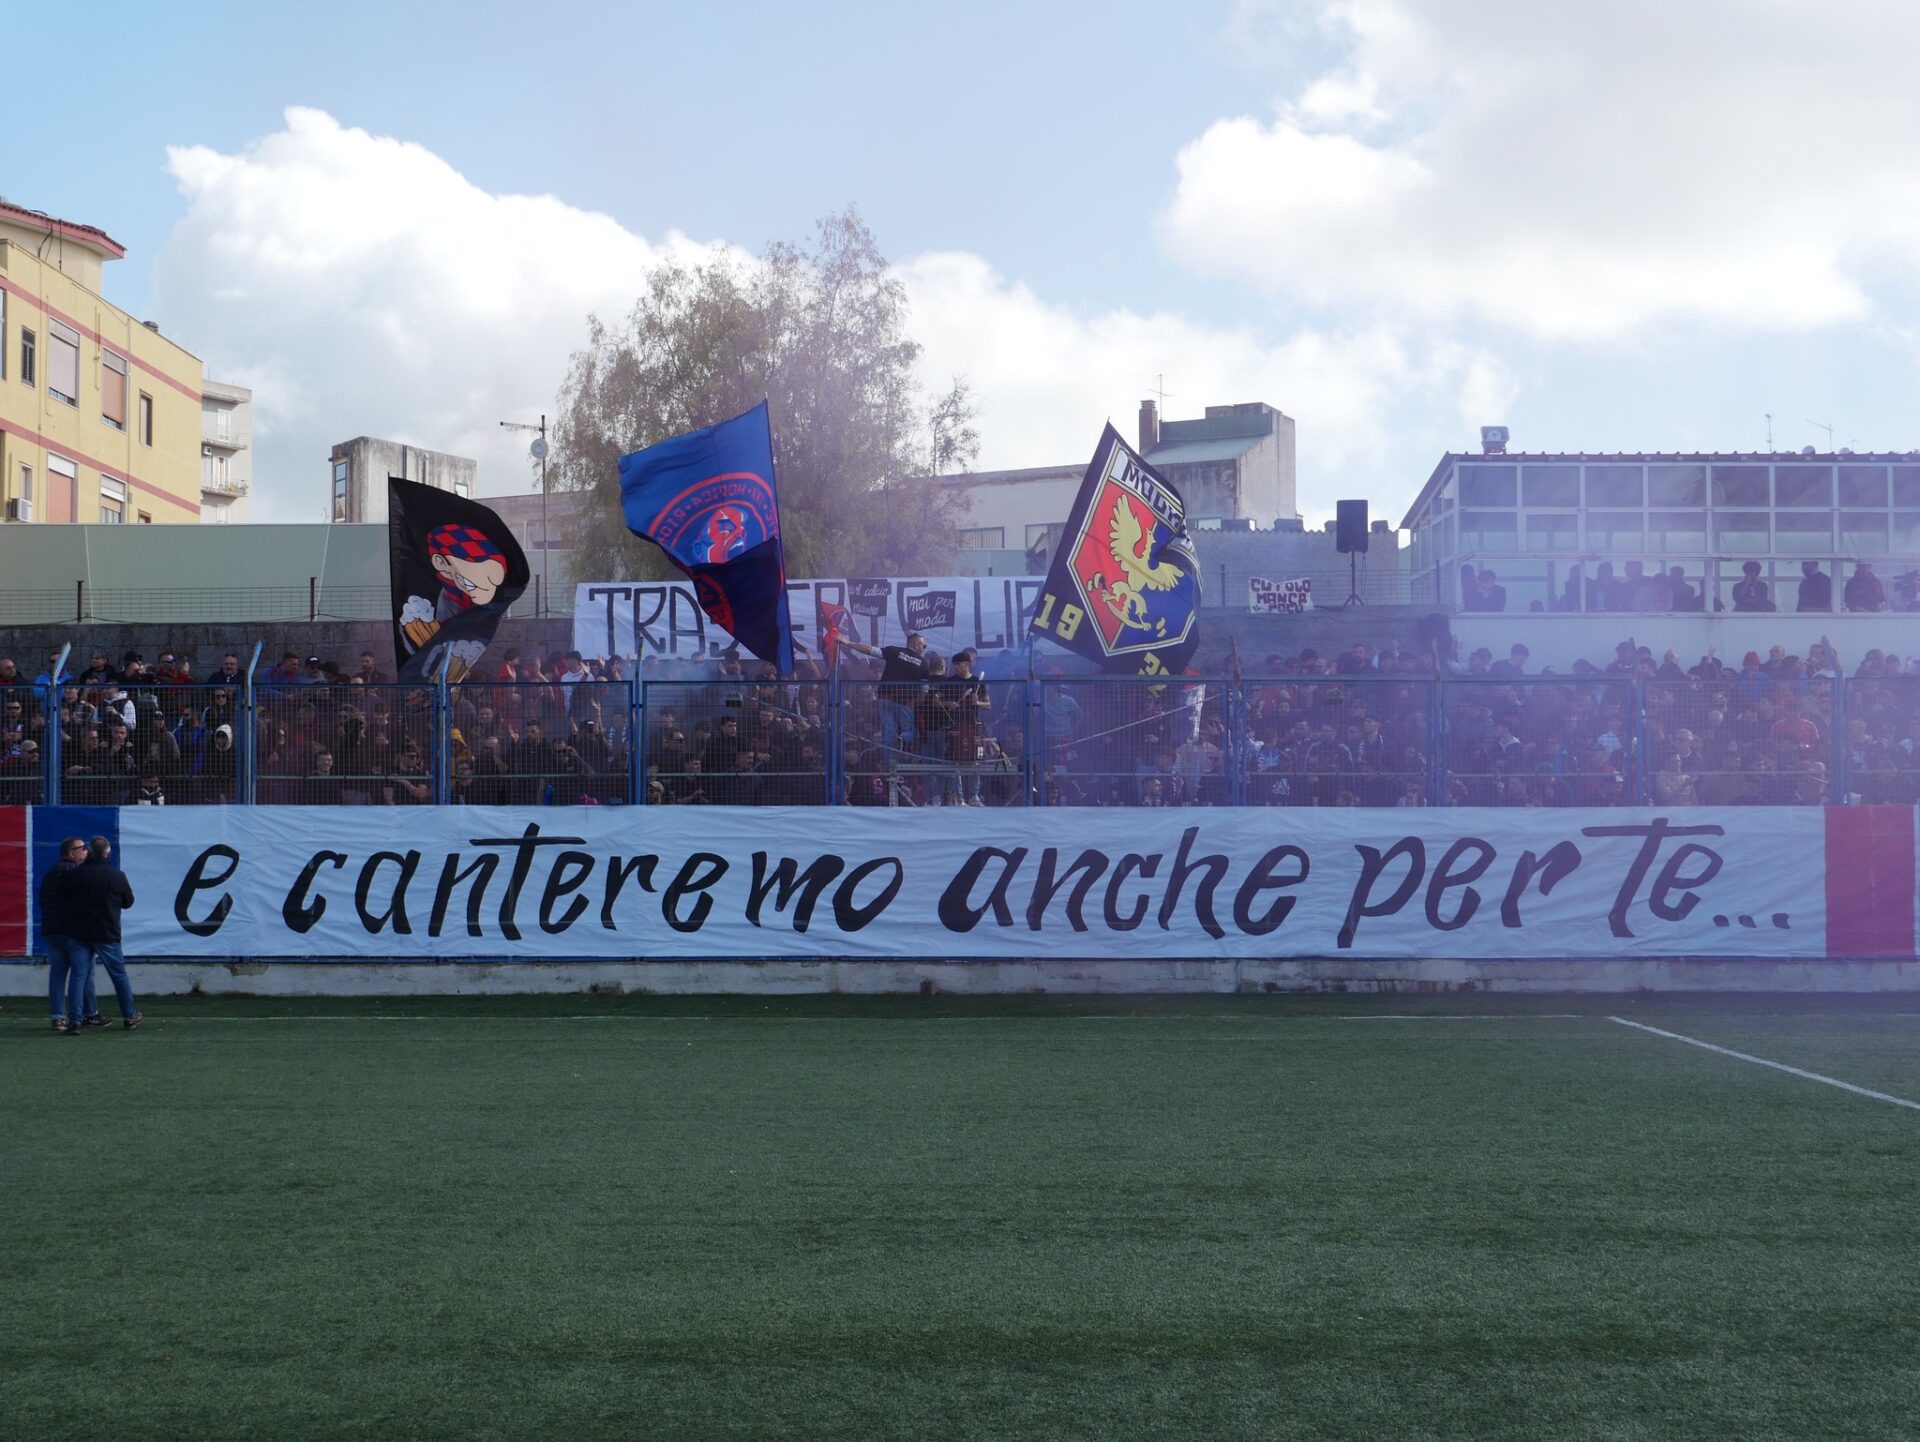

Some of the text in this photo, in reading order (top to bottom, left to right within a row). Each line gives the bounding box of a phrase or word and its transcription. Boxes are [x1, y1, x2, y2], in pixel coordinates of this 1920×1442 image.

[908, 596, 954, 613] mai per
[915, 612, 947, 629] moda
[1033, 593, 1084, 641] 19
[174, 844, 240, 937] e
[282, 822, 904, 940] canteremo
[938, 826, 1310, 940] anche
[1337, 836, 1582, 948] per
